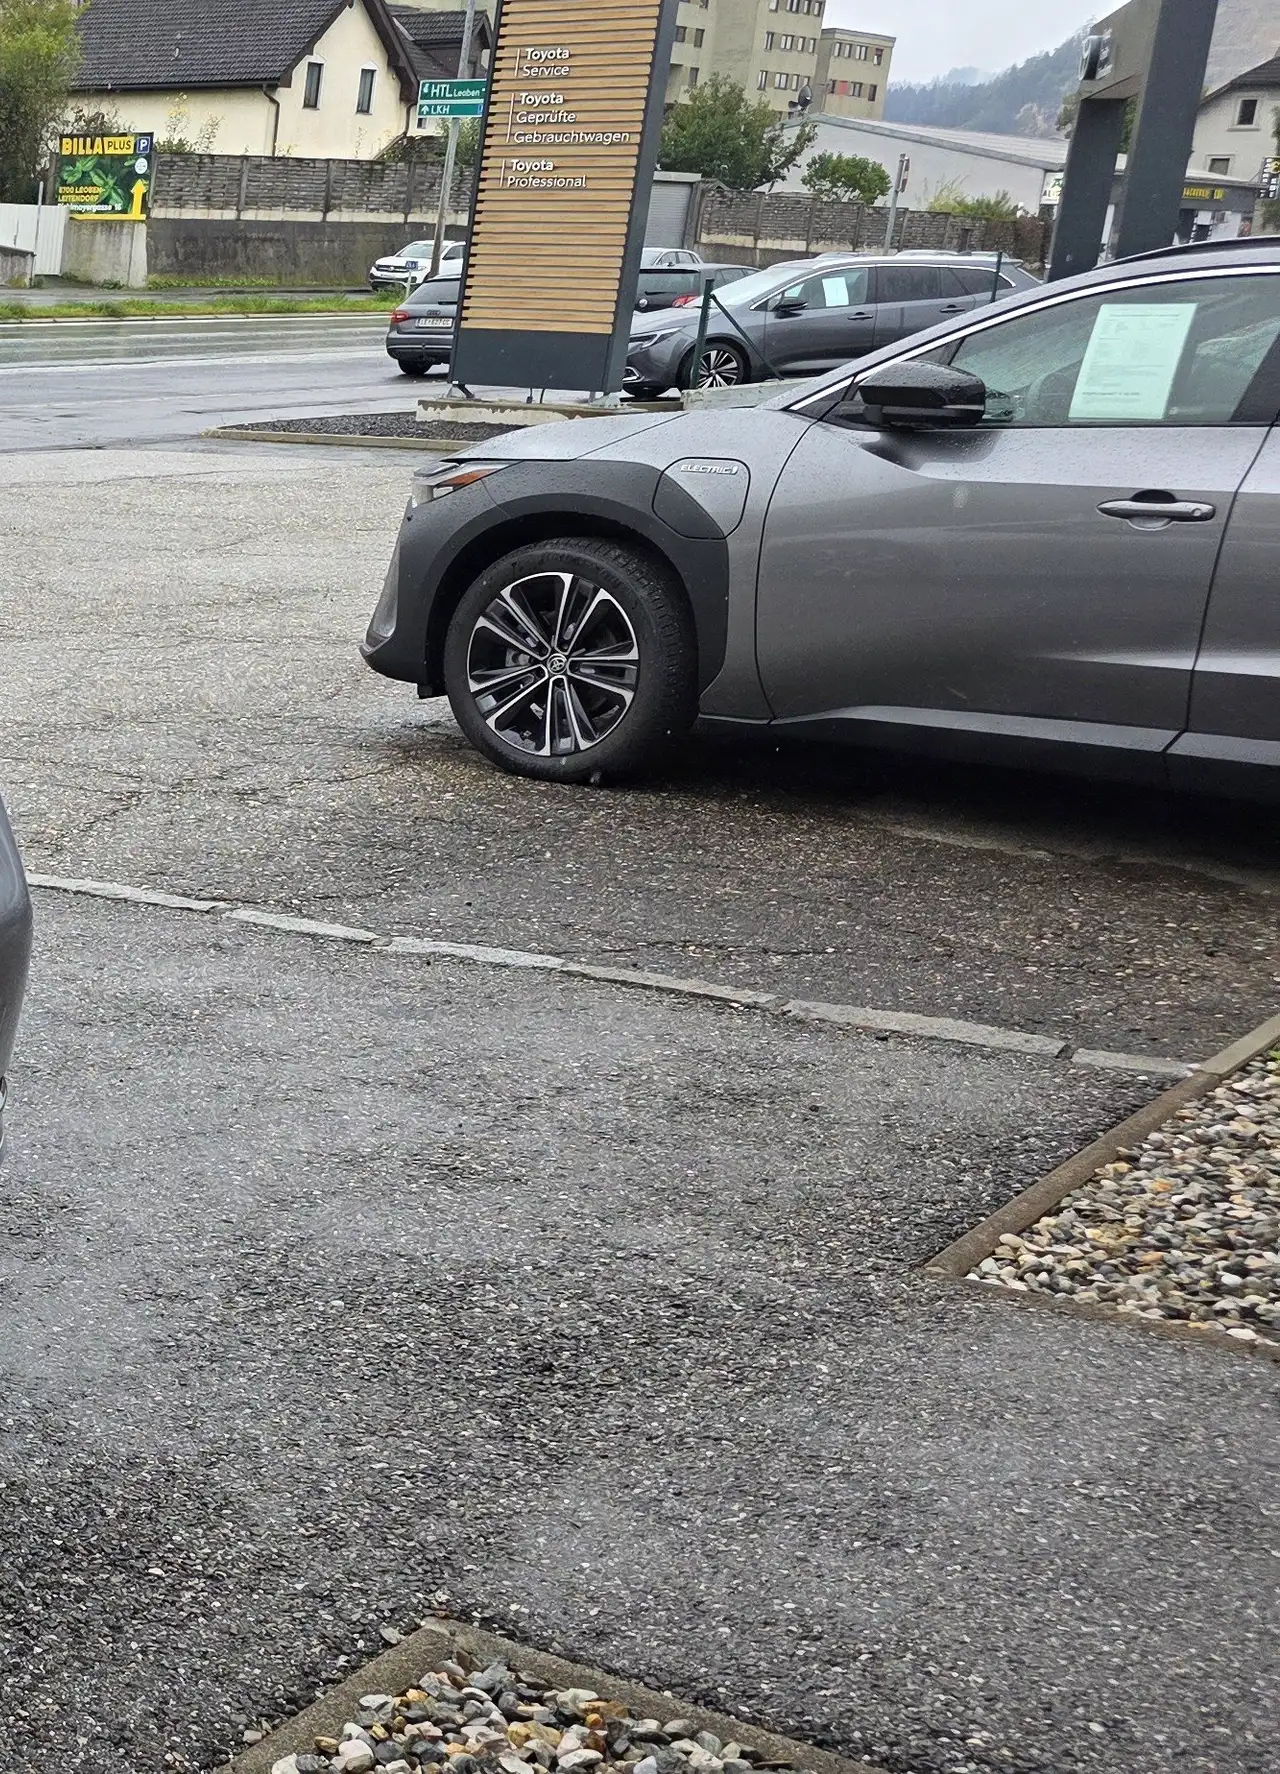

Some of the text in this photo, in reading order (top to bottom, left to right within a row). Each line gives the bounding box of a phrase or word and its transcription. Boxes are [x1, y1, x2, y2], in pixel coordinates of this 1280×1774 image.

[525, 48, 570, 62] Toyota
[523, 64, 570, 77] Service
[431, 84, 480, 97] HTL Leoben
[520, 93, 564, 107] Toyota
[431, 105, 450, 114] LKH
[516, 111, 576, 125] Geprüfte
[514, 131, 630, 145] Gebrauchtwagen
[61, 137, 131, 155] BILLA PLUS
[511, 159, 553, 173] Toyota
[507, 174, 586, 188] Professional
[680, 464, 733, 474] ELECTRIC
